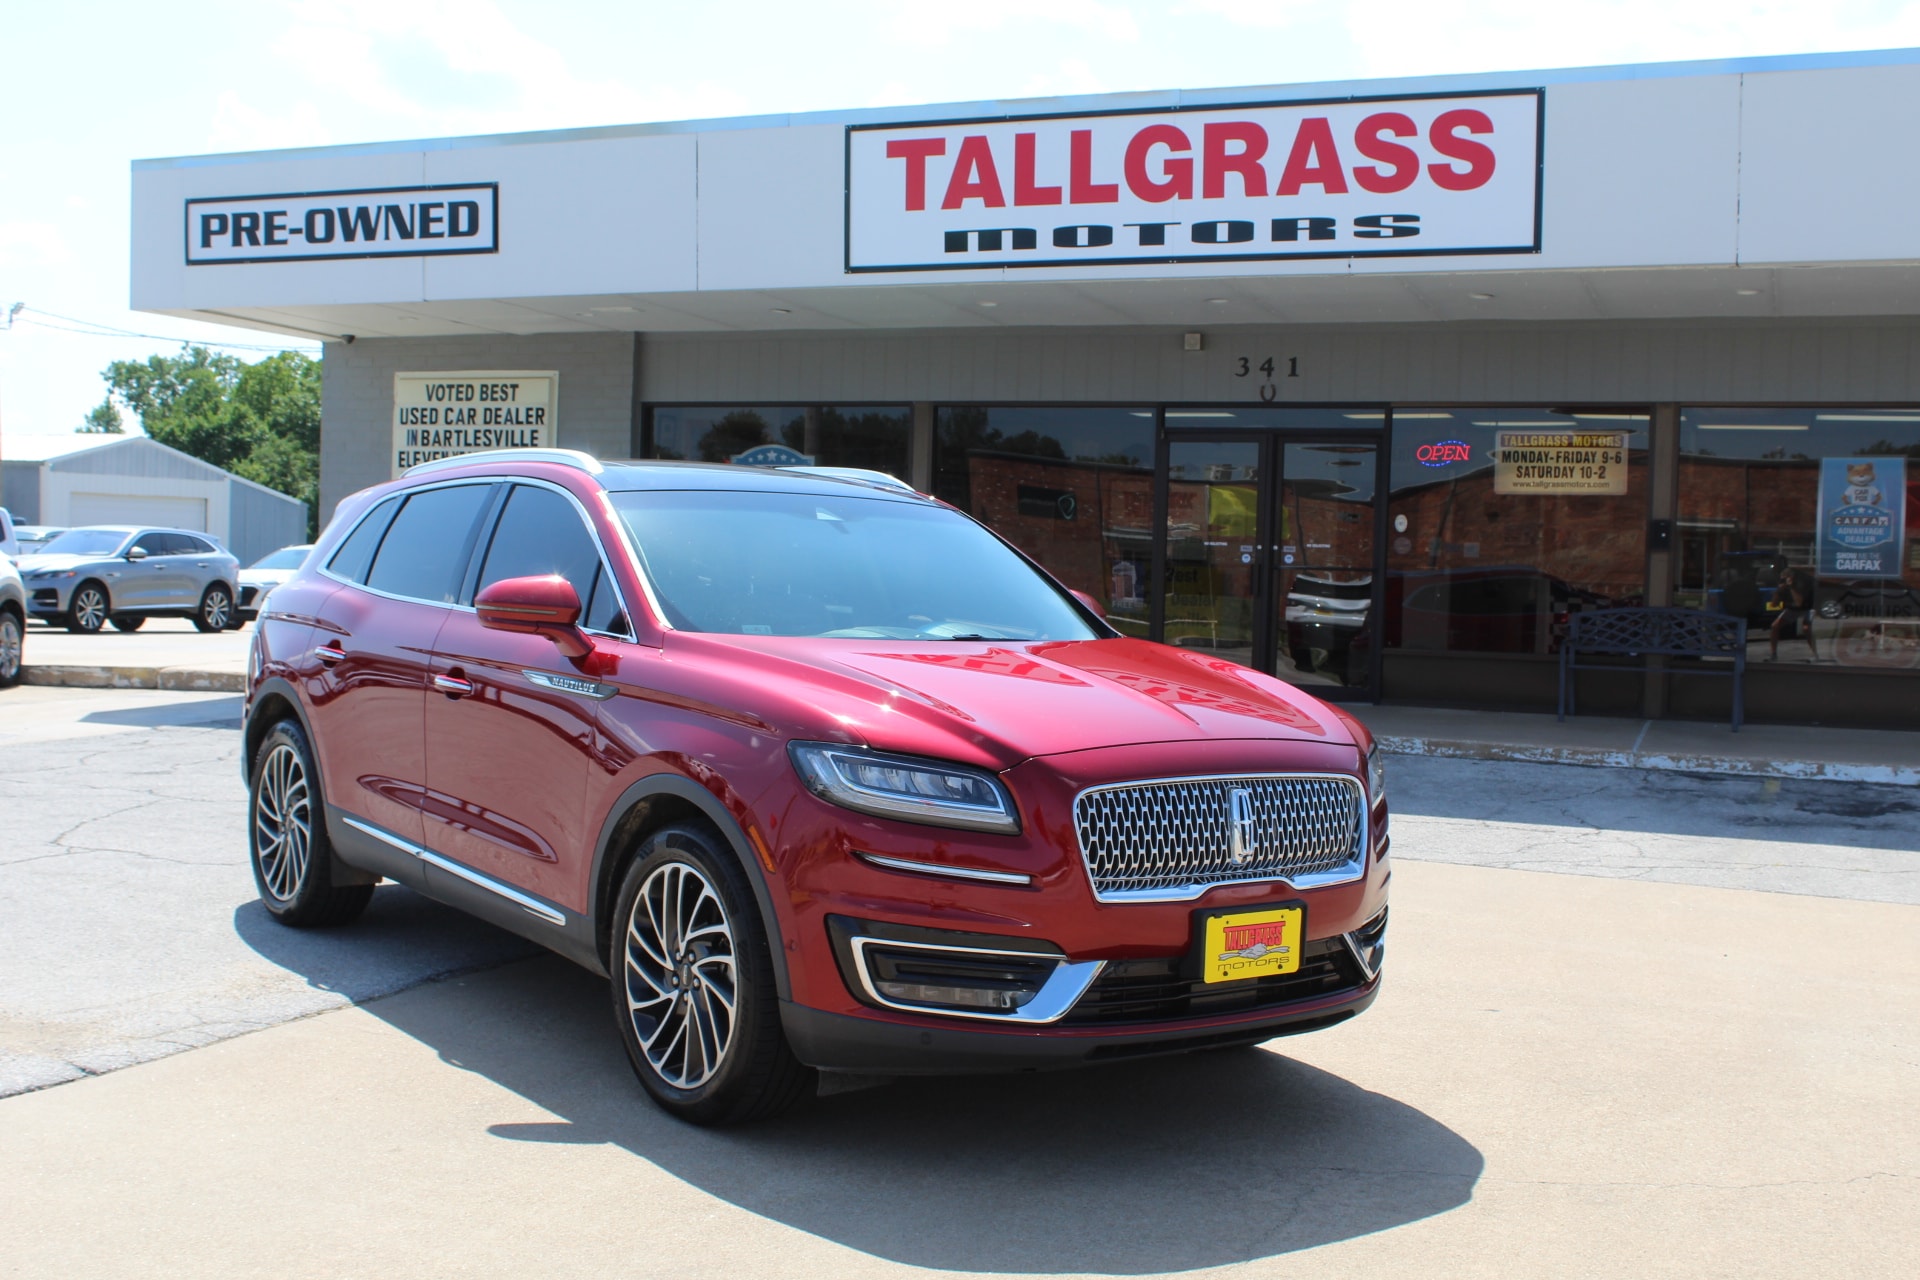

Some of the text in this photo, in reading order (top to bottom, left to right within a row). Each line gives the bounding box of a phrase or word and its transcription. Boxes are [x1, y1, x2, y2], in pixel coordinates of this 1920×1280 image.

[886, 108, 1496, 212] TALLGRASS
[200, 200, 479, 248] PRE-OWNED
[425, 383, 519, 402] VOTED BEST
[400, 407, 545, 425] USED CAR DEALER
[406, 429, 539, 447] IN BARTLESVILLE
[1503, 434, 1622, 447] TALLGRASS MOTORS
[1416, 444, 1471, 461] OPEN
[1501, 450, 1622, 464] MONDAY-FRIDAY 9-6
[1516, 465, 1606, 478] SATURDAY 10-2
[1836, 560, 1881, 571] CARFAX
[552, 677, 596, 692] NAUTILUS
[1223, 921, 1286, 951] TALLGRASS
[1218, 957, 1290, 971] MOTORS
